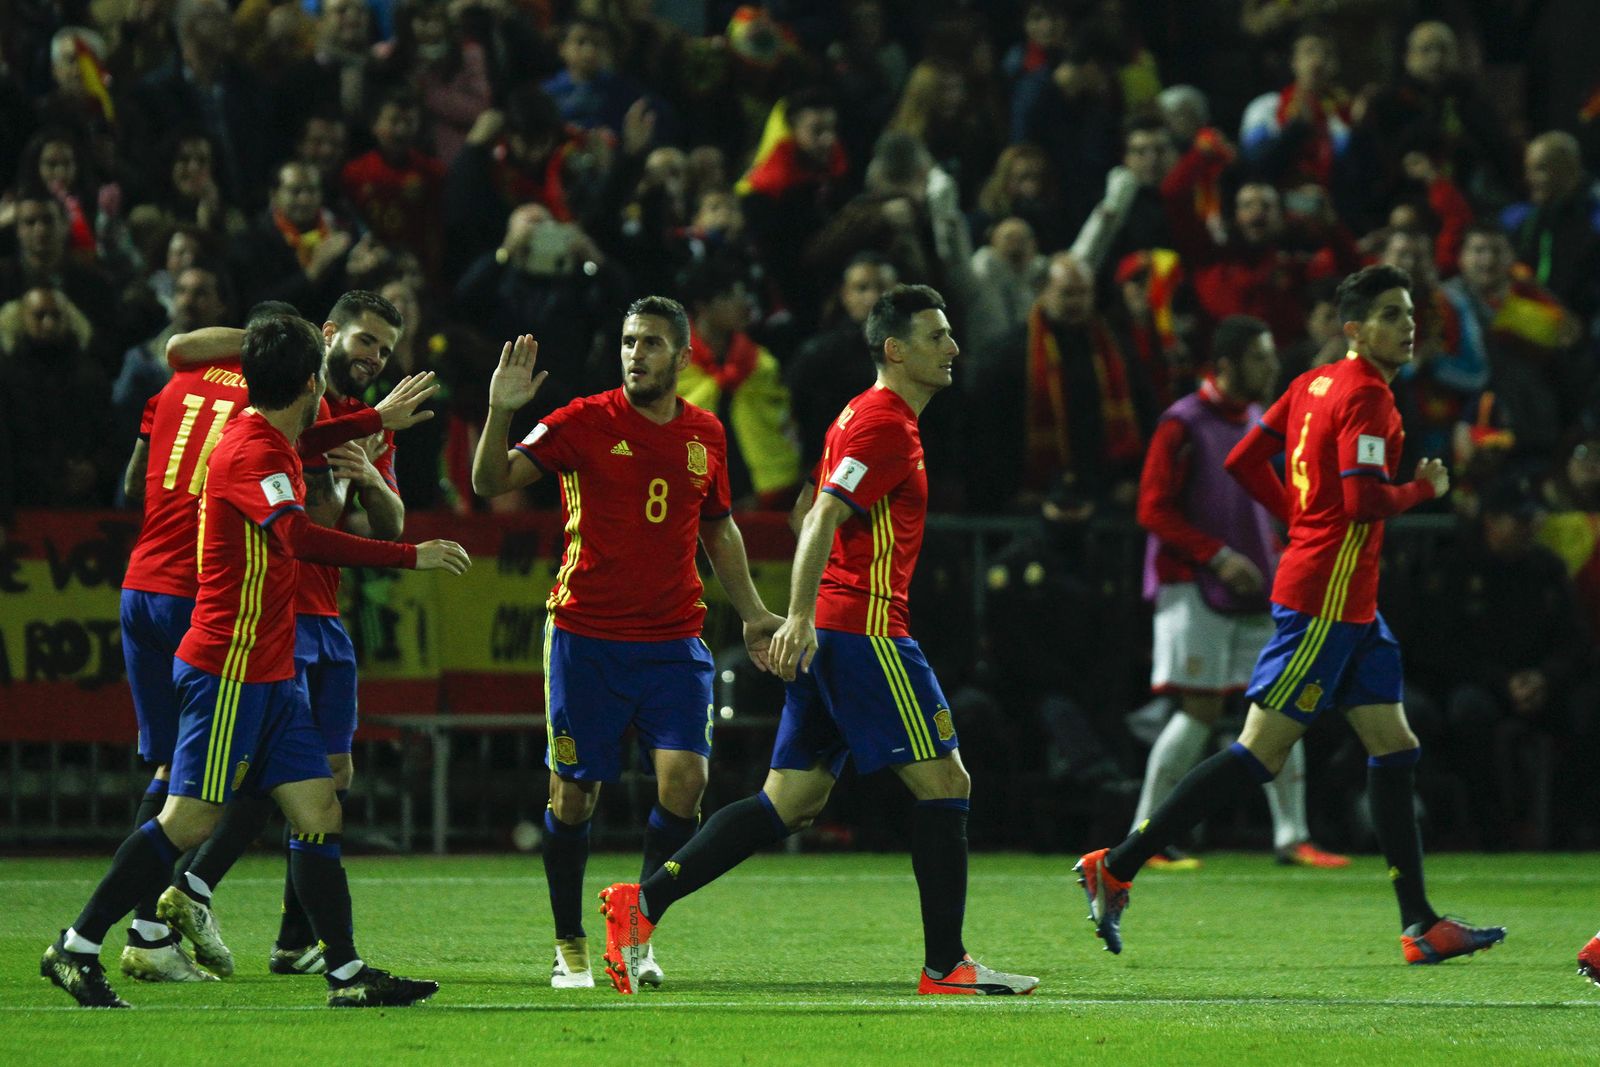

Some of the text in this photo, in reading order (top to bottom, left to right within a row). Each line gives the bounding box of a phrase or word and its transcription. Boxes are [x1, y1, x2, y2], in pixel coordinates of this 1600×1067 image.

[163, 393, 235, 497] 11
[1291, 412, 1312, 512] 4
[645, 478, 668, 523] 8
